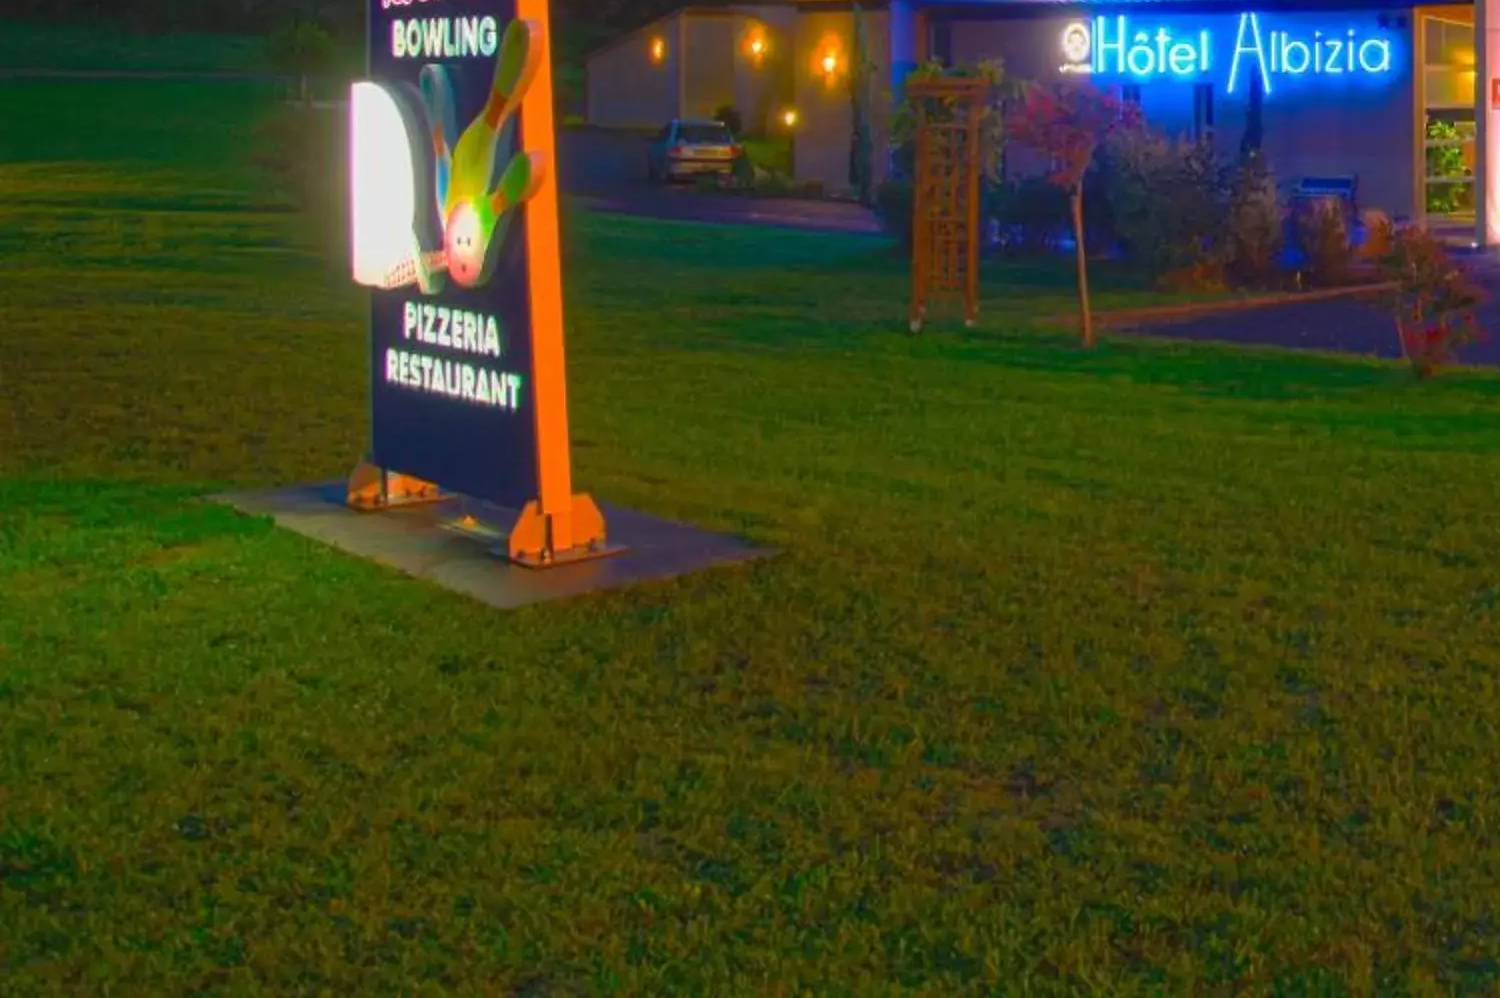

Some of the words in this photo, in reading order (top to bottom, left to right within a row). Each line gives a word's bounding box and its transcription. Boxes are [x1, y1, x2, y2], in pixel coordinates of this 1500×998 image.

[392, 15, 497, 57] BOWLING
[1096, 14, 1212, 75] Hôtel
[1226, 11, 1392, 96] Albizia
[404, 301, 500, 357] PIZZERIA
[386, 347, 522, 409] RESTAURANT
